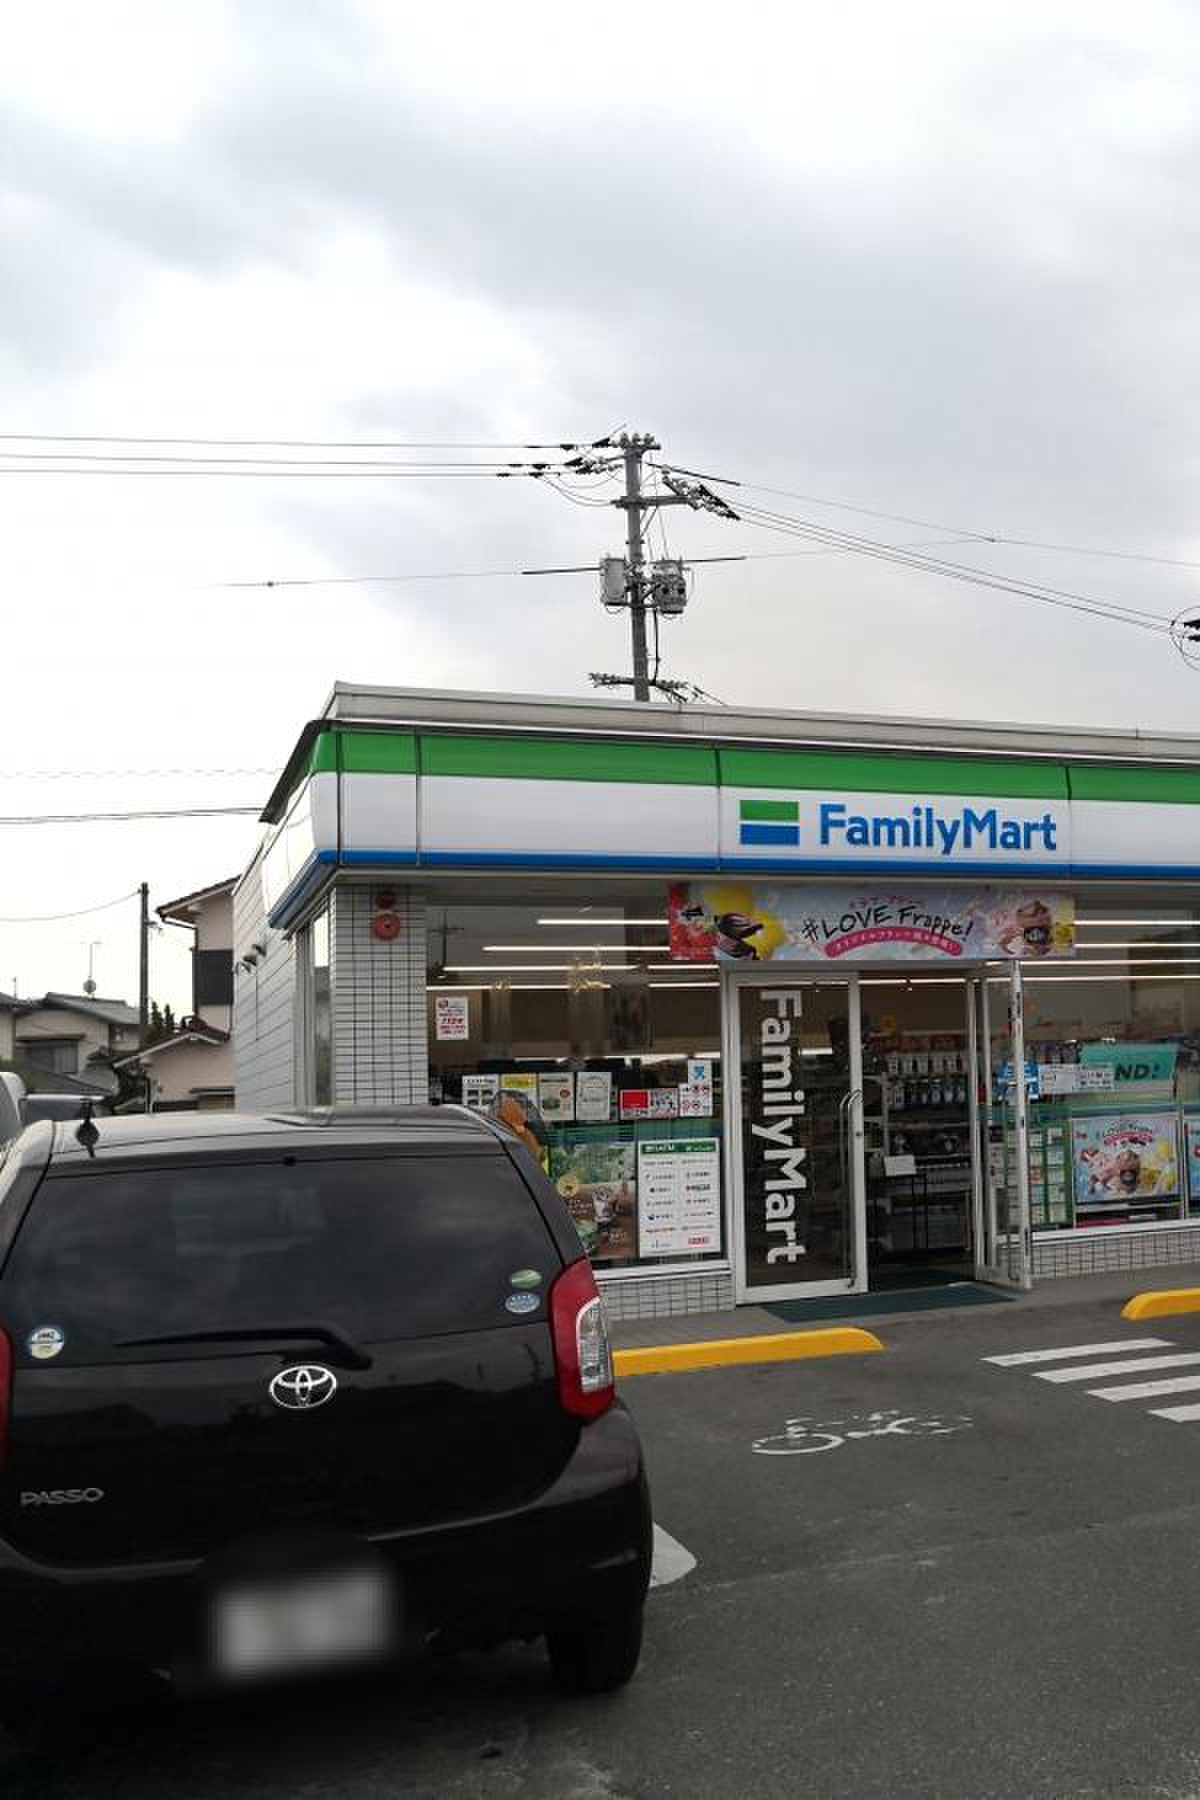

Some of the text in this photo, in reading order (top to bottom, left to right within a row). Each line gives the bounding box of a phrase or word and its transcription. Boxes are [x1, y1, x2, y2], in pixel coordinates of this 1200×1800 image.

[819, 803, 1057, 855] FamilyMart
[801, 905, 893, 943] #LOVE
[899, 905, 974, 941] Frappe!
[752, 990, 807, 1264] FamilyMart
[20, 1487, 104, 1507] PASSO
